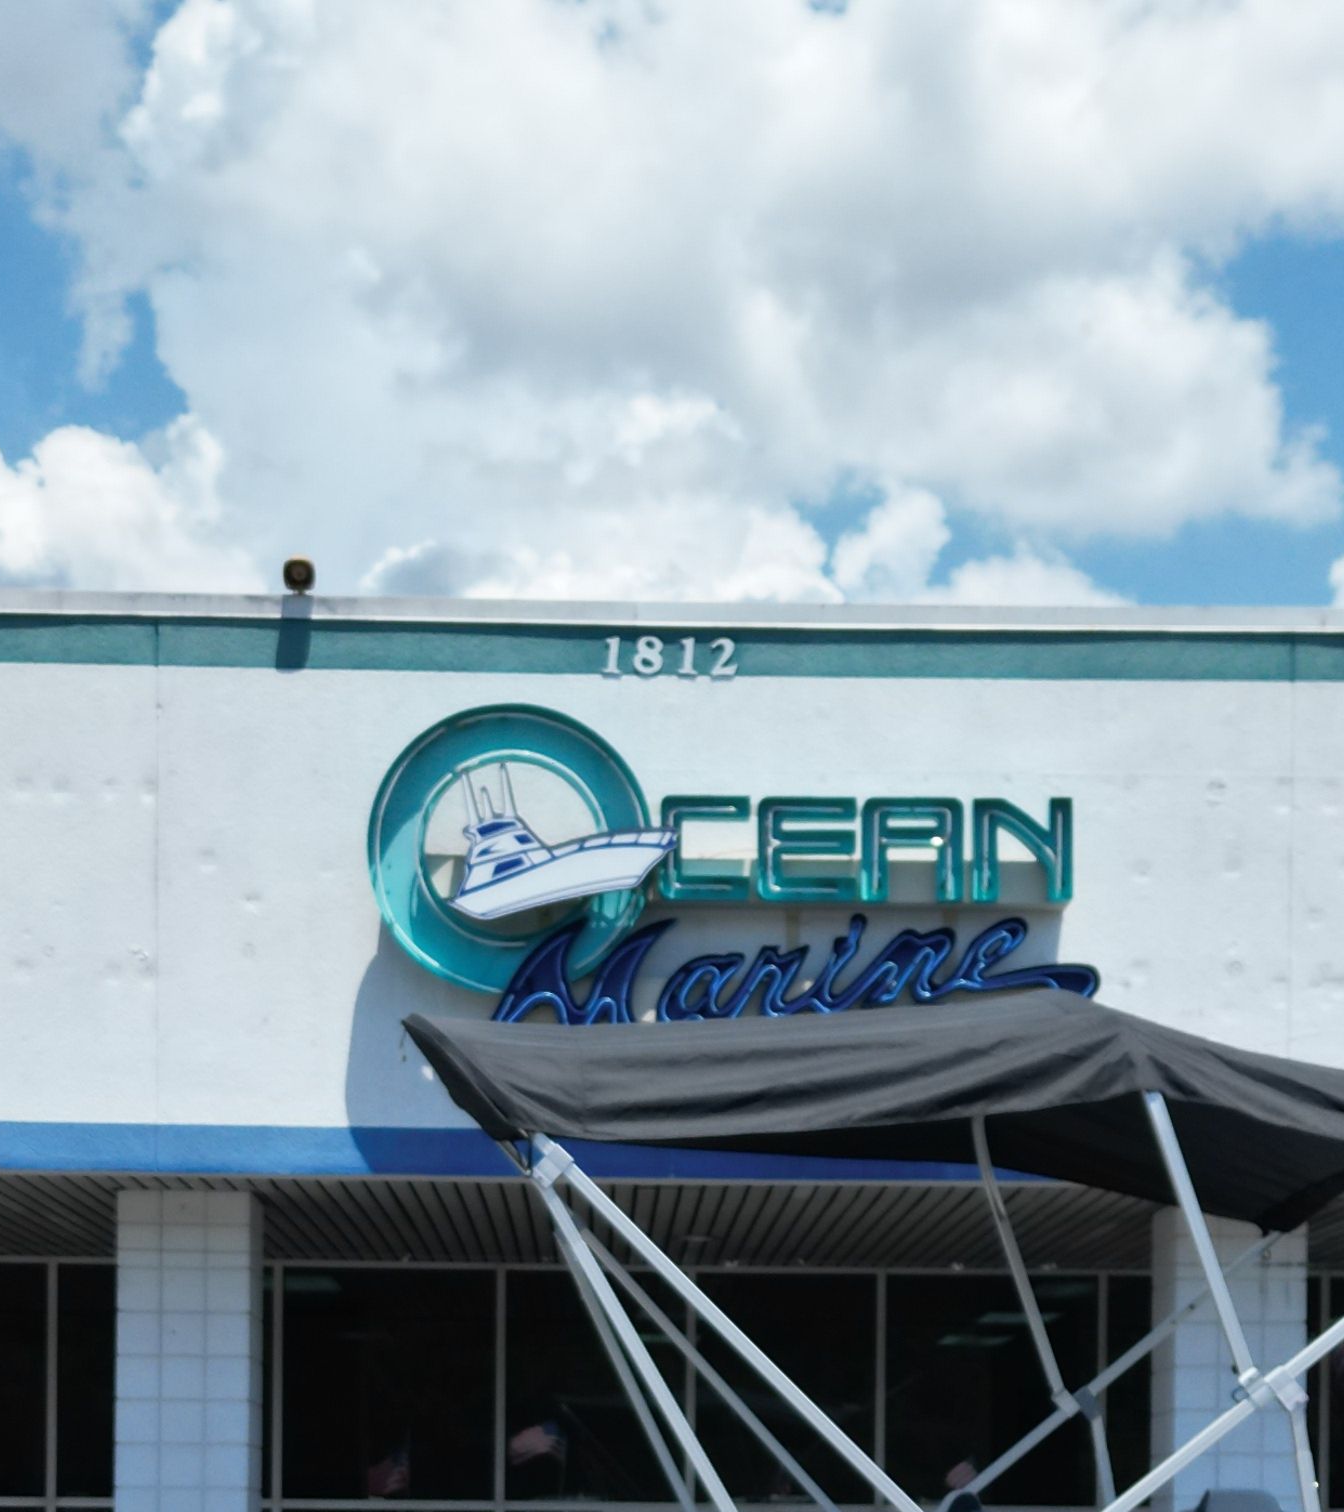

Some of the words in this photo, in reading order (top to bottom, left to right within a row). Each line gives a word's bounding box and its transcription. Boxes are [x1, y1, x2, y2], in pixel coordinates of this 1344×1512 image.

[600, 635, 739, 677] 1812
[367, 703, 1073, 994] OCEAN
[492, 913, 1101, 1025] Marine
